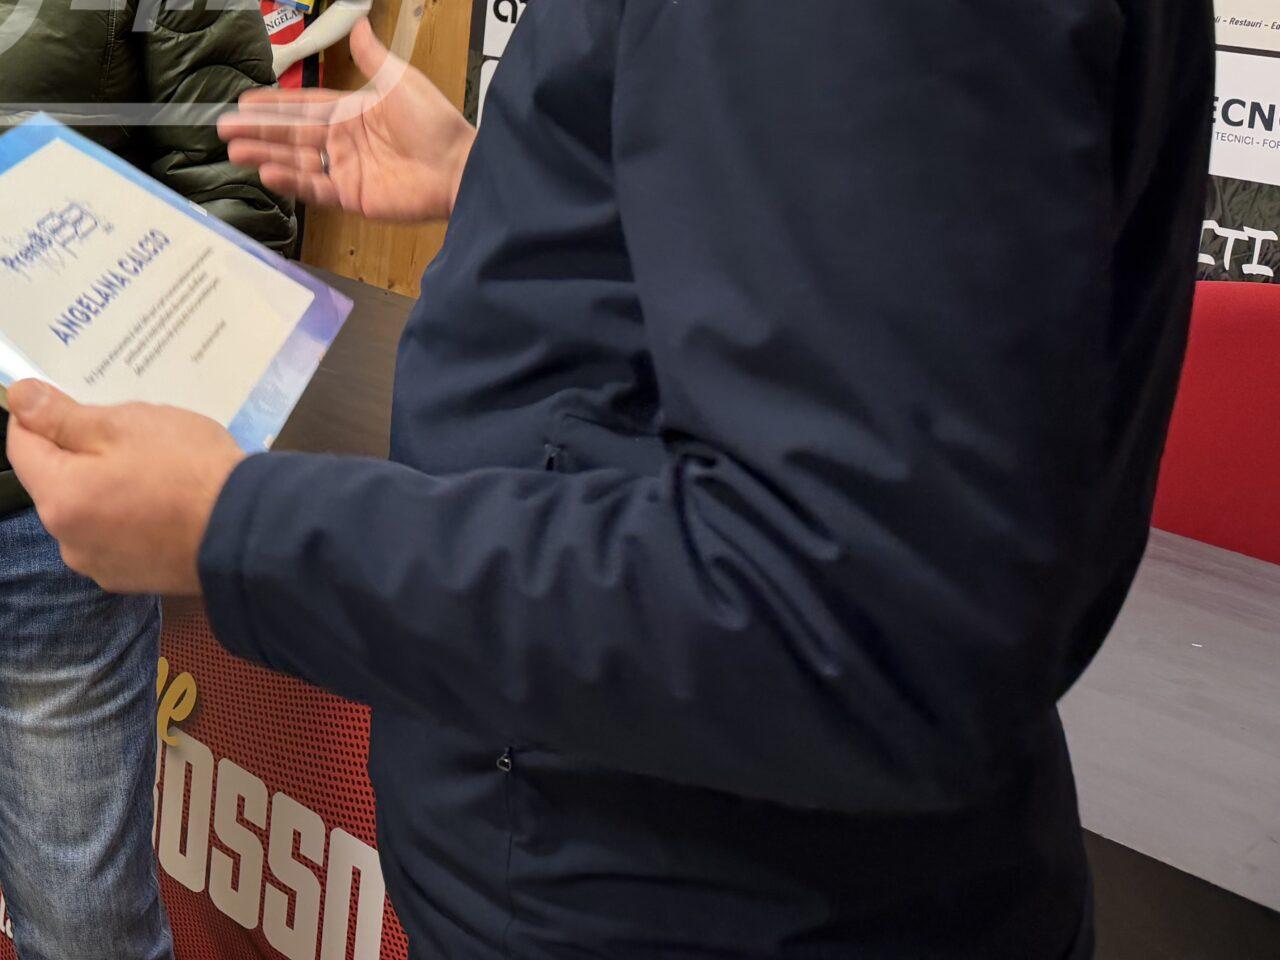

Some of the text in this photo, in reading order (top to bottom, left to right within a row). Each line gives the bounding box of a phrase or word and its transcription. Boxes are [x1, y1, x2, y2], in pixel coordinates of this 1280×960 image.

[1229, 17, 1263, 29] Restauri
[1216, 131, 1254, 146] TECNICI
[48, 269, 131, 347] ANGELANA
